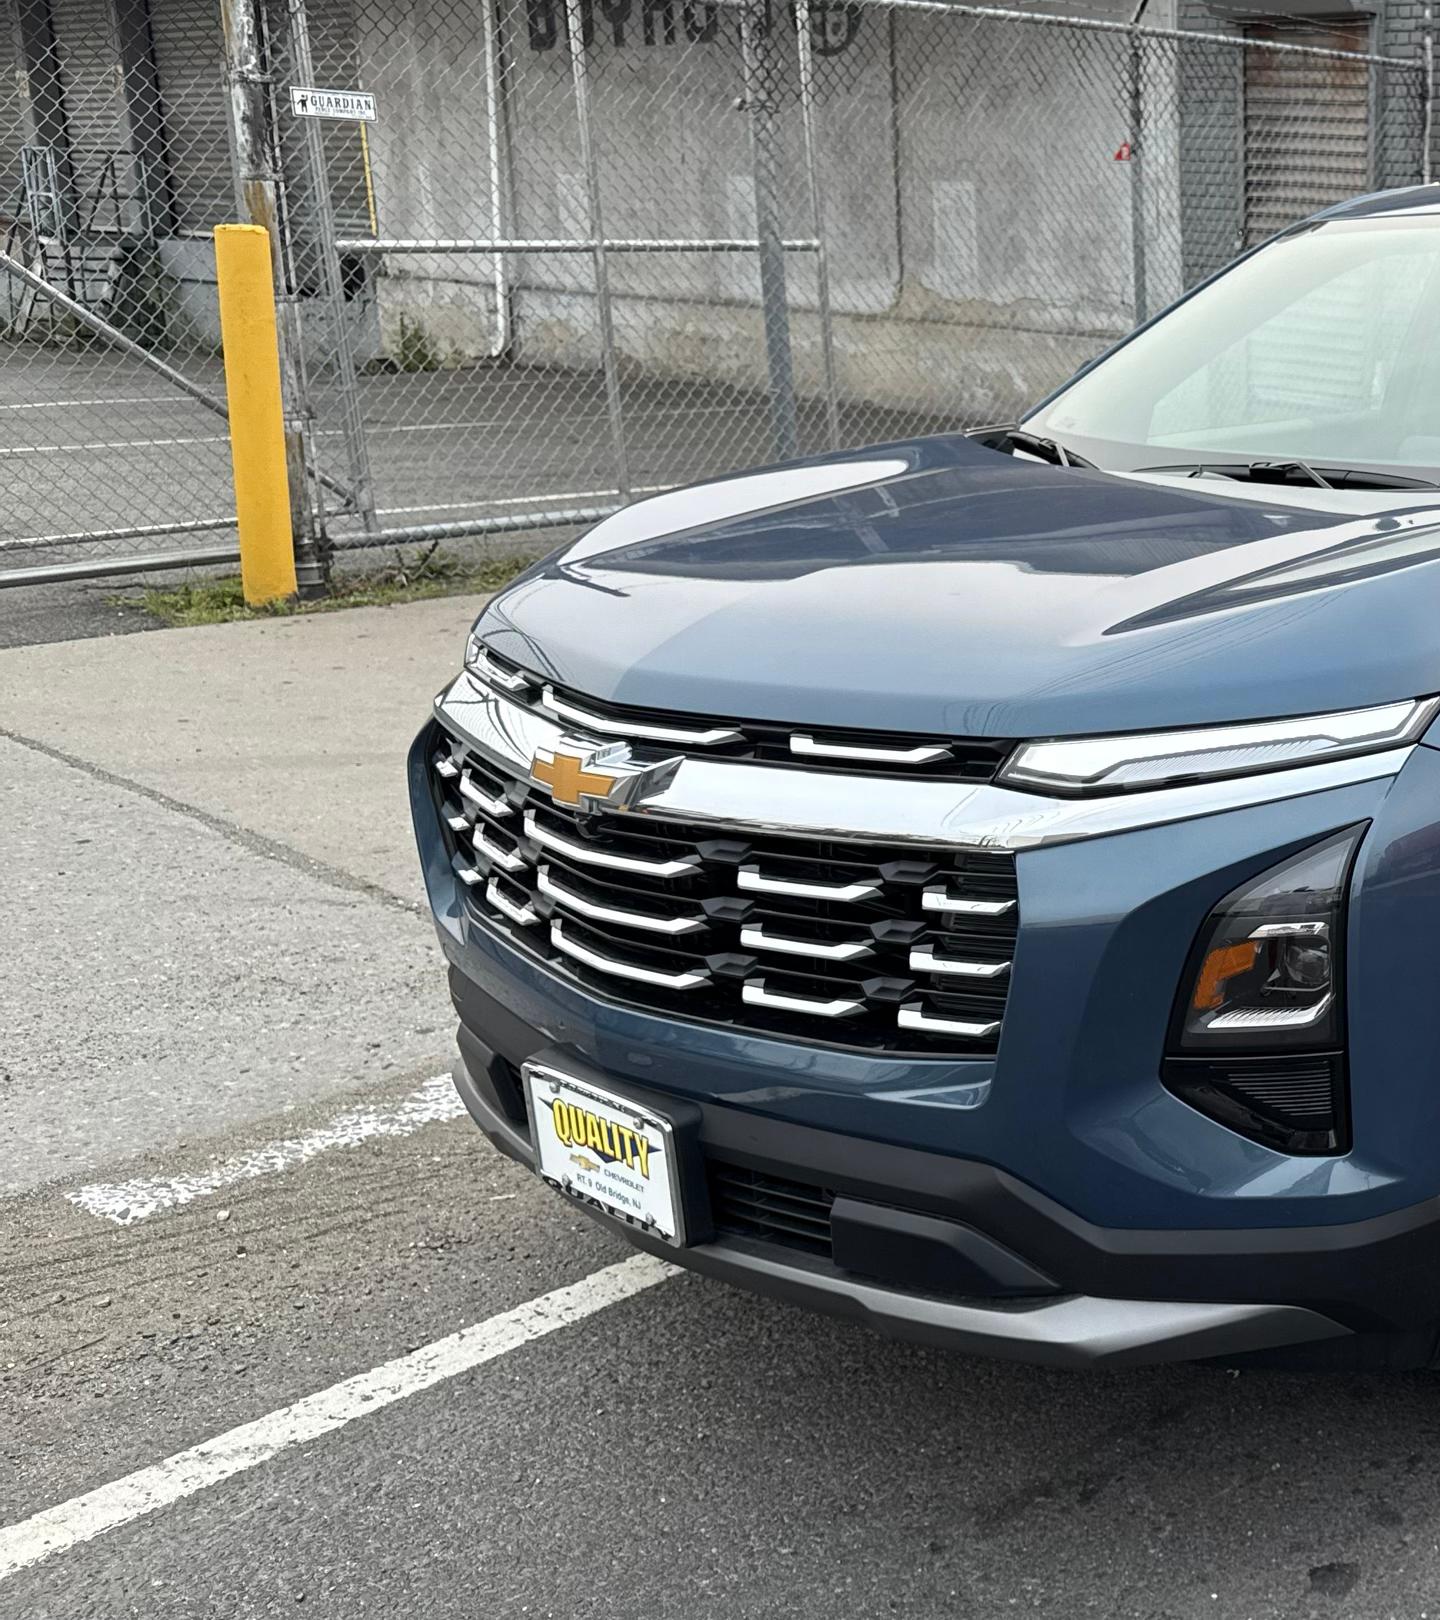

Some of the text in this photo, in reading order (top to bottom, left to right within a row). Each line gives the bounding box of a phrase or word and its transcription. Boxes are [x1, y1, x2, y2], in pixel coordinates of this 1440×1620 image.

[310, 95, 372, 110] GUARDIAN
[552, 1097, 650, 1181] QUALITY
[603, 1168, 645, 1193] CHEVROLET
[595, 1181, 608, 1194] Old
[632, 1199, 642, 1210] NJ
